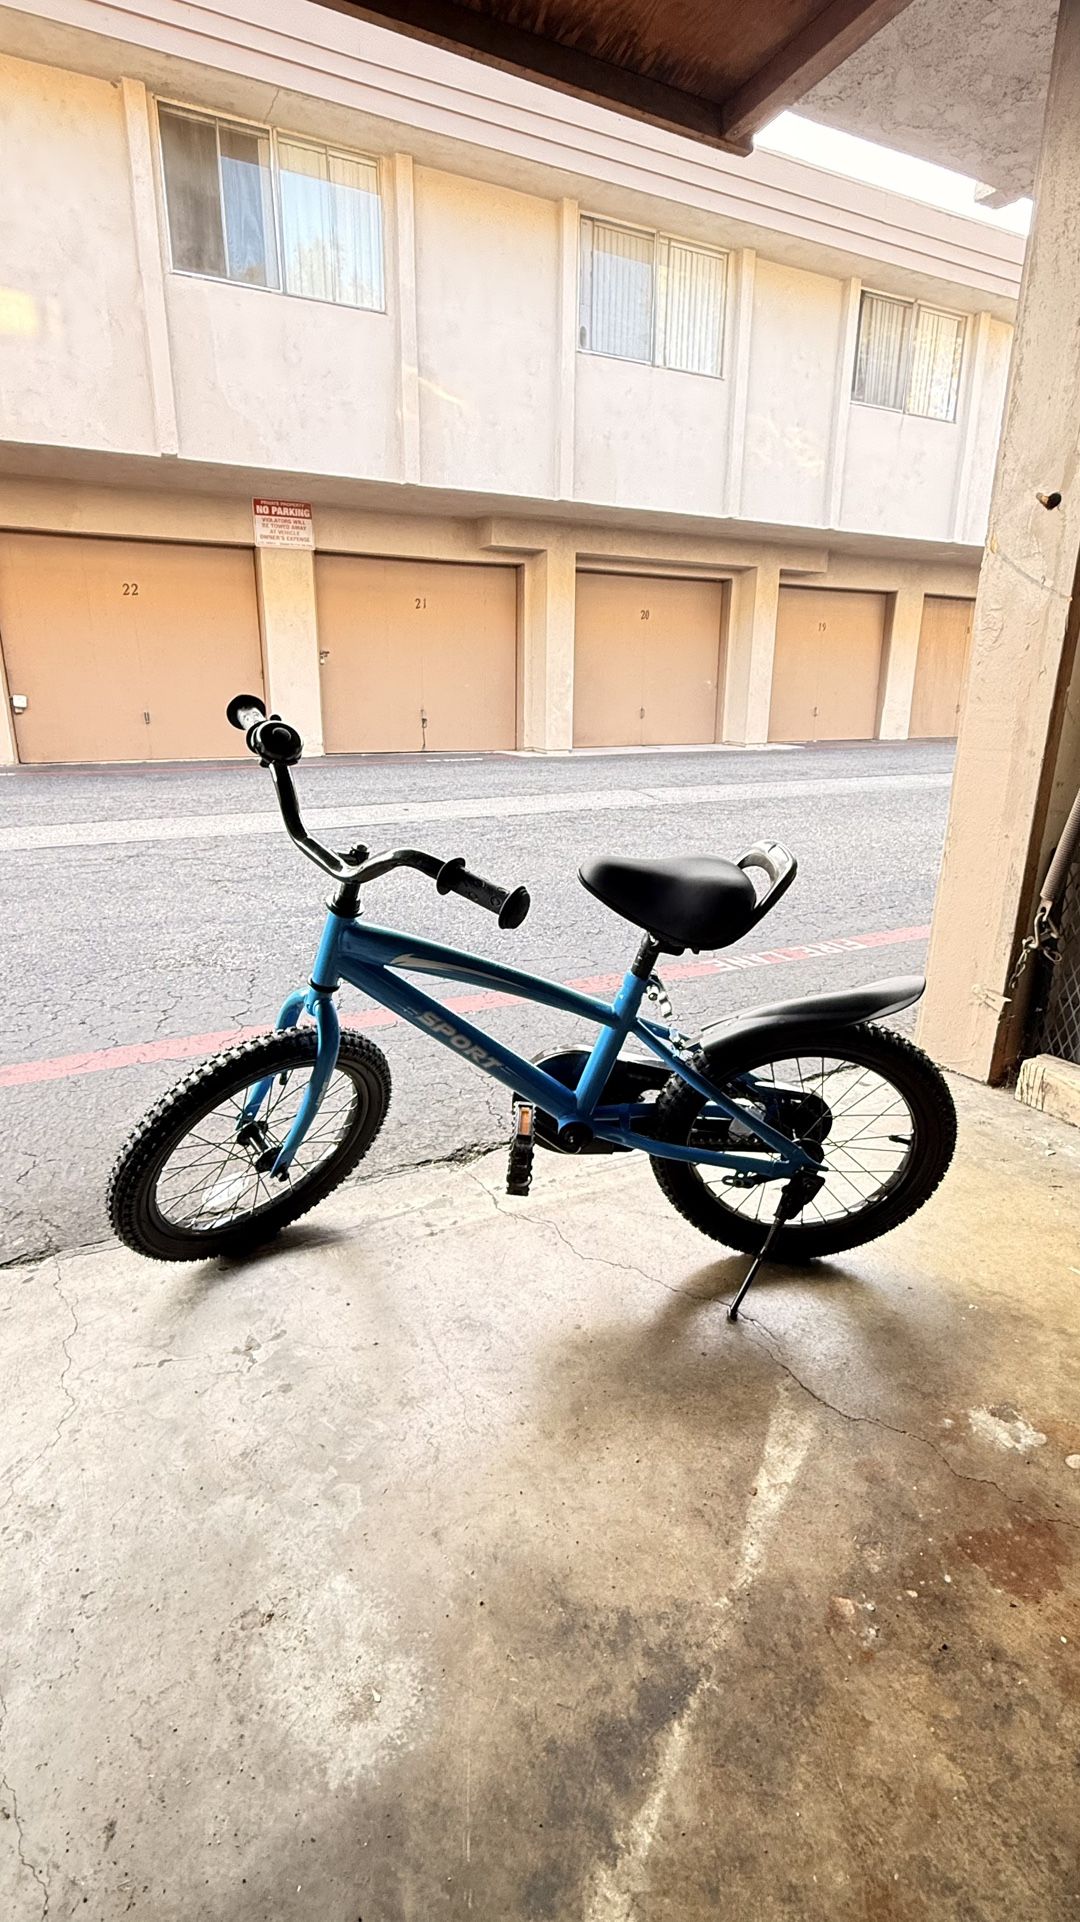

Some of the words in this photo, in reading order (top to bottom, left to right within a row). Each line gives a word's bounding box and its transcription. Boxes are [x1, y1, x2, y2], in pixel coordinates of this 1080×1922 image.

[256, 505, 269, 514] NO
[271, 506, 310, 517] PARKING
[122, 583, 139, 596] 22
[414, 598, 427, 609] 21
[640, 609, 650, 620] 20
[818, 622, 827, 632] 19
[790, 938, 868, 957] FIRE
[701, 949, 792, 972] LANE
[415, 1011, 503, 1069] SPORT
